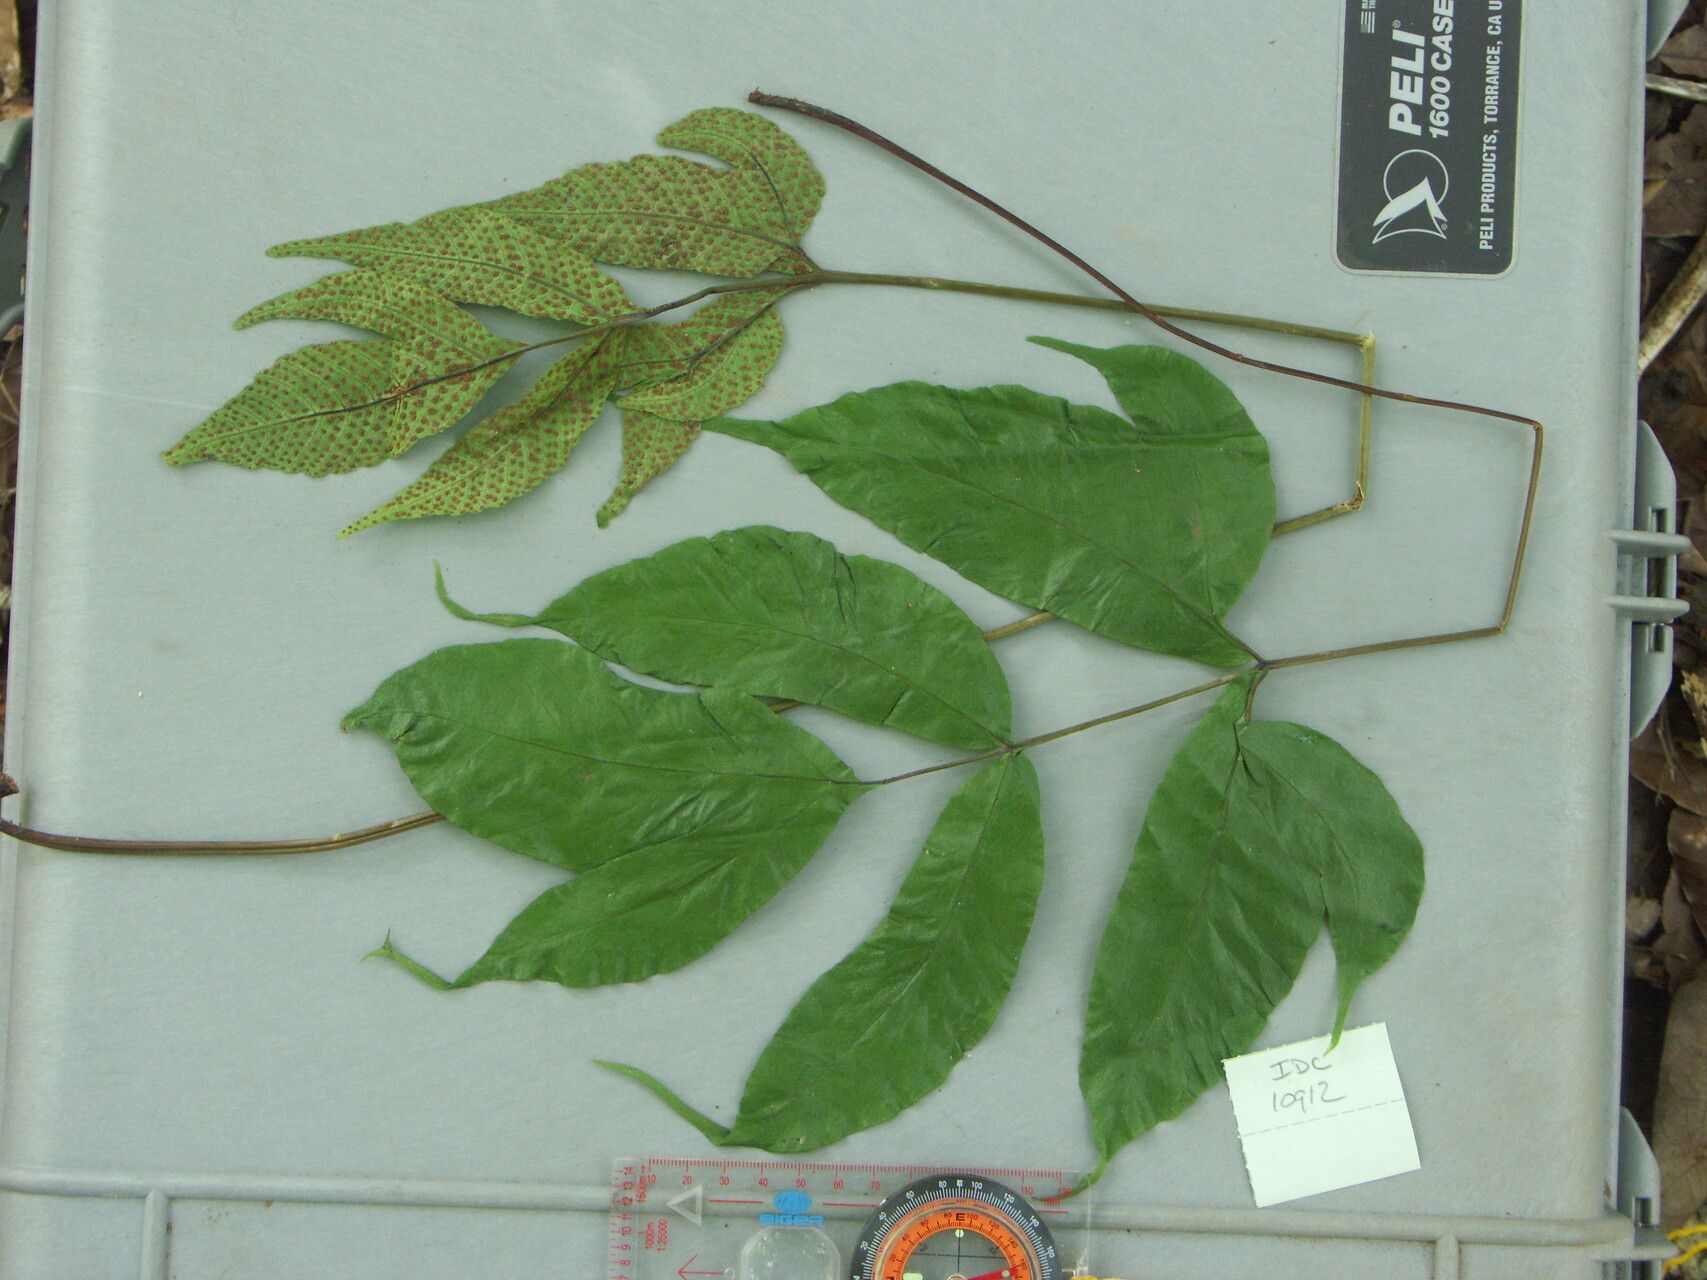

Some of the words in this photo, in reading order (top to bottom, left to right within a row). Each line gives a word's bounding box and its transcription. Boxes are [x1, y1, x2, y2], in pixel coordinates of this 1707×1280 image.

[1430, 0, 1454, 72] CASE
[1487, 14, 1503, 36] CA
[1388, 28, 1426, 136] PELI
[1483, 40, 1504, 124] TORRANCE,
[1429, 75, 1451, 139] 1600
[1480, 129, 1500, 214] PRODUCTS,
[1479, 217, 1494, 250] PELI
[1269, 1056, 1333, 1081] IDC
[1272, 1080, 1347, 1115] 10912
[681, 1175, 692, 1186] 20
[719, 1176, 730, 1186] 30
[758, 1177, 769, 1188] 40
[796, 1178, 807, 1189] 50
[833, 1179, 844, 1190] 60
[870, 1180, 881, 1191] 70
[955, 1212, 966, 1222] E
[971, 1181, 983, 1190] 100
[1003, 1192, 1015, 1204] 120
[1029, 1214, 1040, 1227] 140
